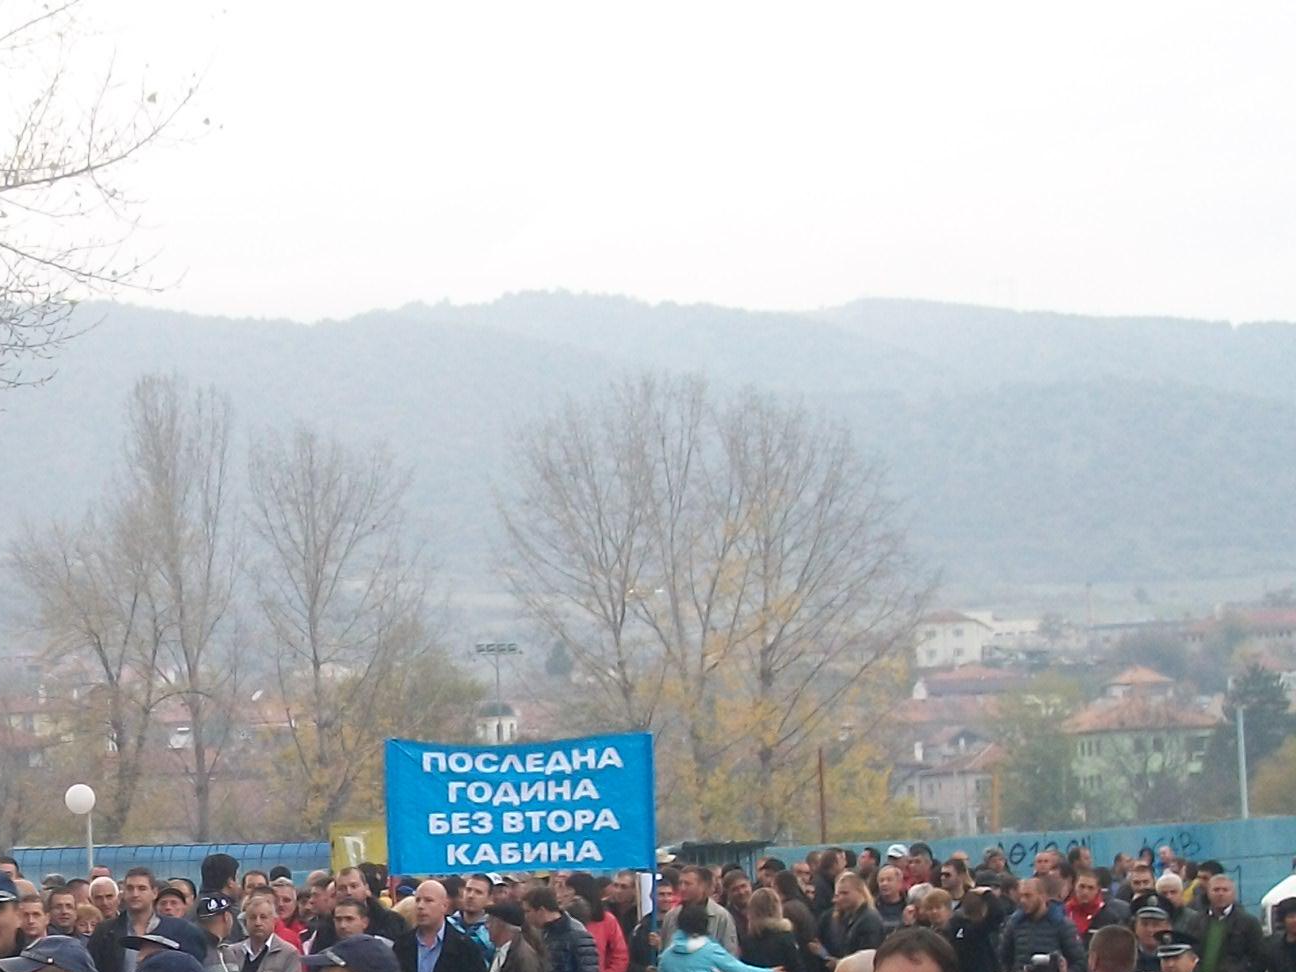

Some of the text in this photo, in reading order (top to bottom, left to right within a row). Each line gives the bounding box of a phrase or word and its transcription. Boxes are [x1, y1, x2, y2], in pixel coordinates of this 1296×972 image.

[422, 747, 624, 775] ПОСЛЕДНА
[447, 778, 600, 807] ГОДИНА
[428, 808, 621, 836] БЕЗ ВТОРА
[446, 839, 604, 866] КАБИНА
